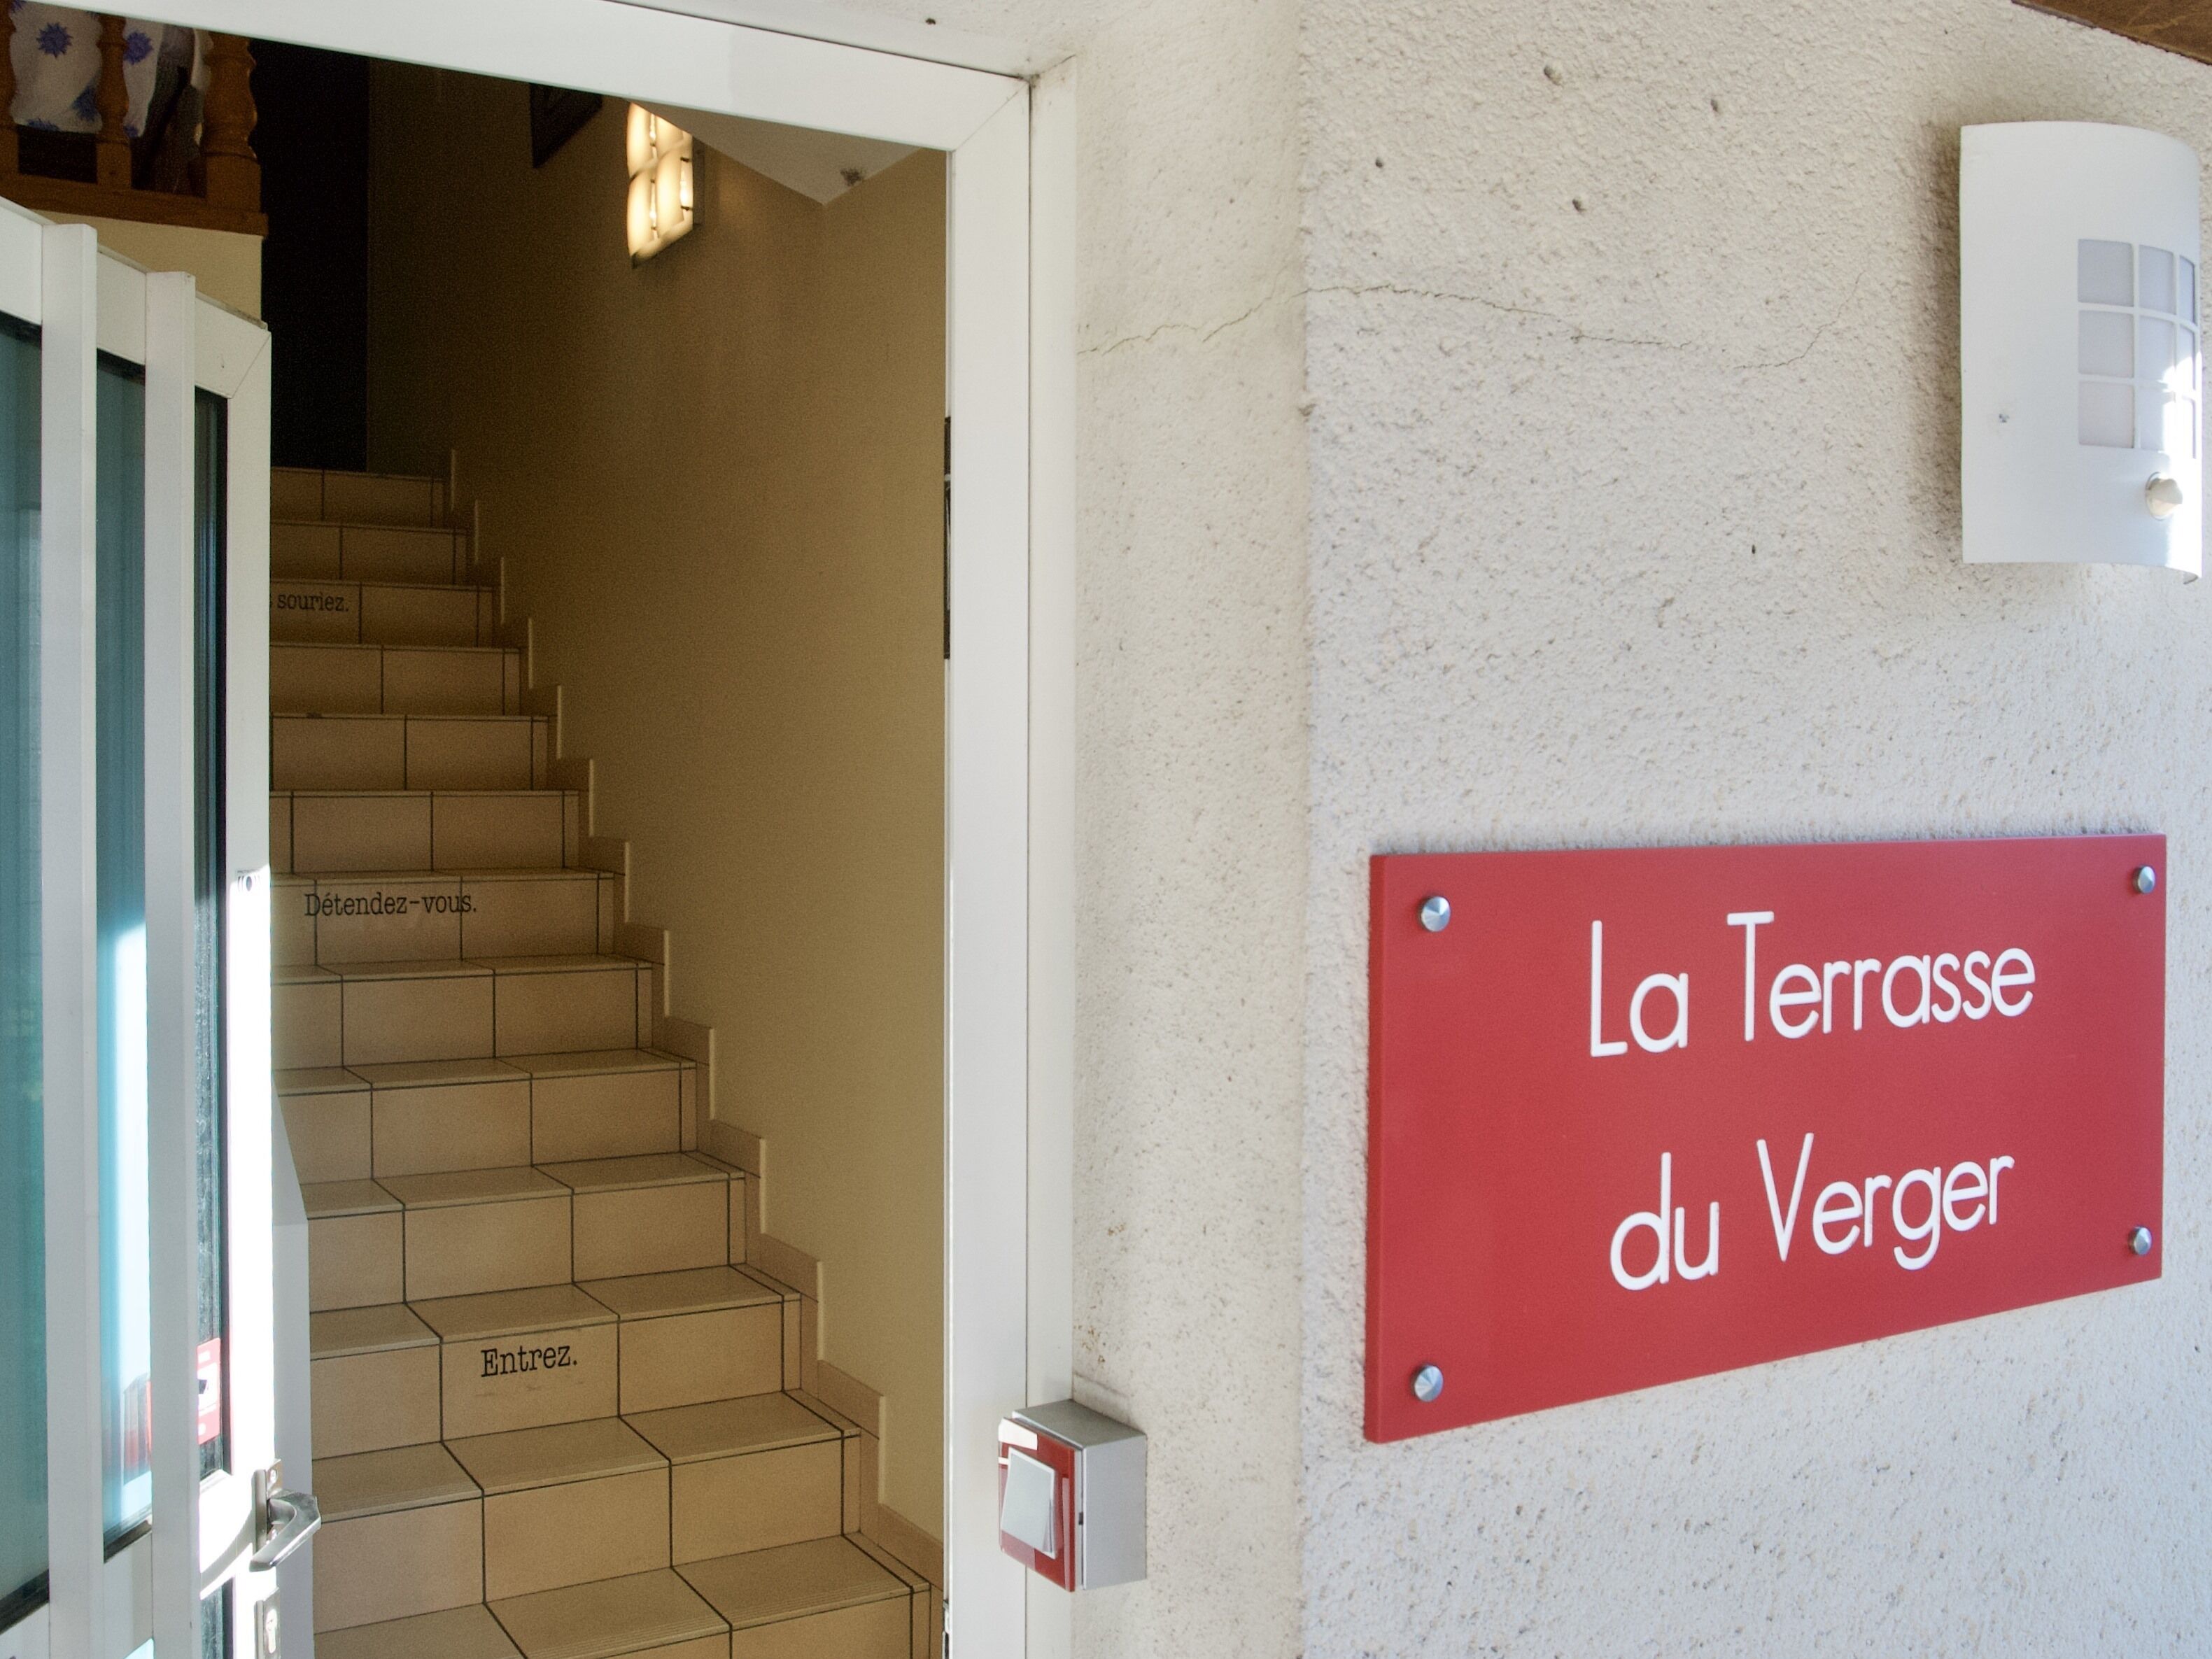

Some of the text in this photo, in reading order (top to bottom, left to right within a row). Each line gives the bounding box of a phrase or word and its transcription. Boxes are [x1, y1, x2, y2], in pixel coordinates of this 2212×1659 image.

[276, 592, 349, 612] souriez.
[304, 891, 477, 917] Détendez-vous.
[1590, 910, 2036, 1057] La Terrasse
[1609, 1132, 2015, 1291] du Verger
[480, 1344, 578, 1378] Entrez.
